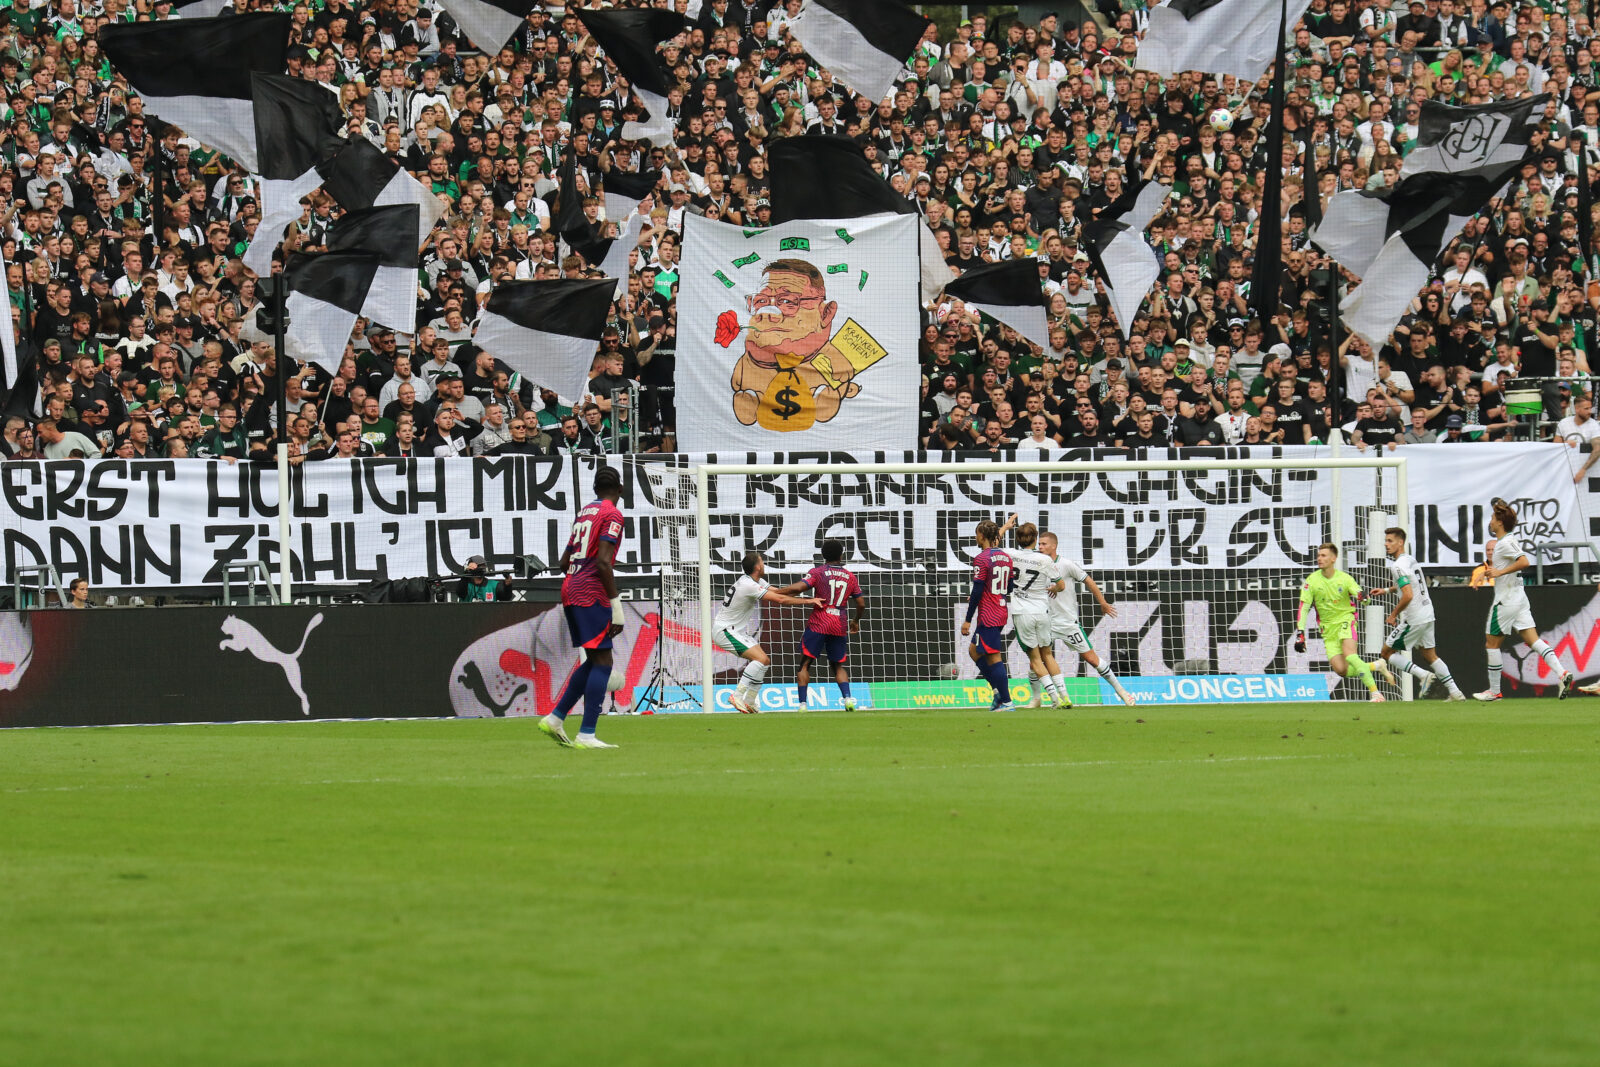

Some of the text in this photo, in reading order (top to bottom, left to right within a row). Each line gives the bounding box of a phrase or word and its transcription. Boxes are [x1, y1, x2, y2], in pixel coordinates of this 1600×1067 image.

[843, 334, 870, 359] SCHEIN
[845, 326, 879, 355] KRANKEN
[1, 460, 175, 521] ERST
[207, 460, 328, 518] HOL
[351, 457, 447, 515] ICH
[473, 455, 566, 512] MIR
[4, 523, 181, 585] DANN
[426, 516, 526, 579] ICH
[1082, 507, 1208, 567] FÜR
[829, 579, 848, 607] 17
[991, 566, 1010, 595] 20
[1067, 633, 1083, 645] 30
[716, 686, 832, 710] OGEN
[913, 694, 960, 706] www.
[1161, 676, 1287, 701] JONGEN
[1293, 685, 1316, 698] .de
